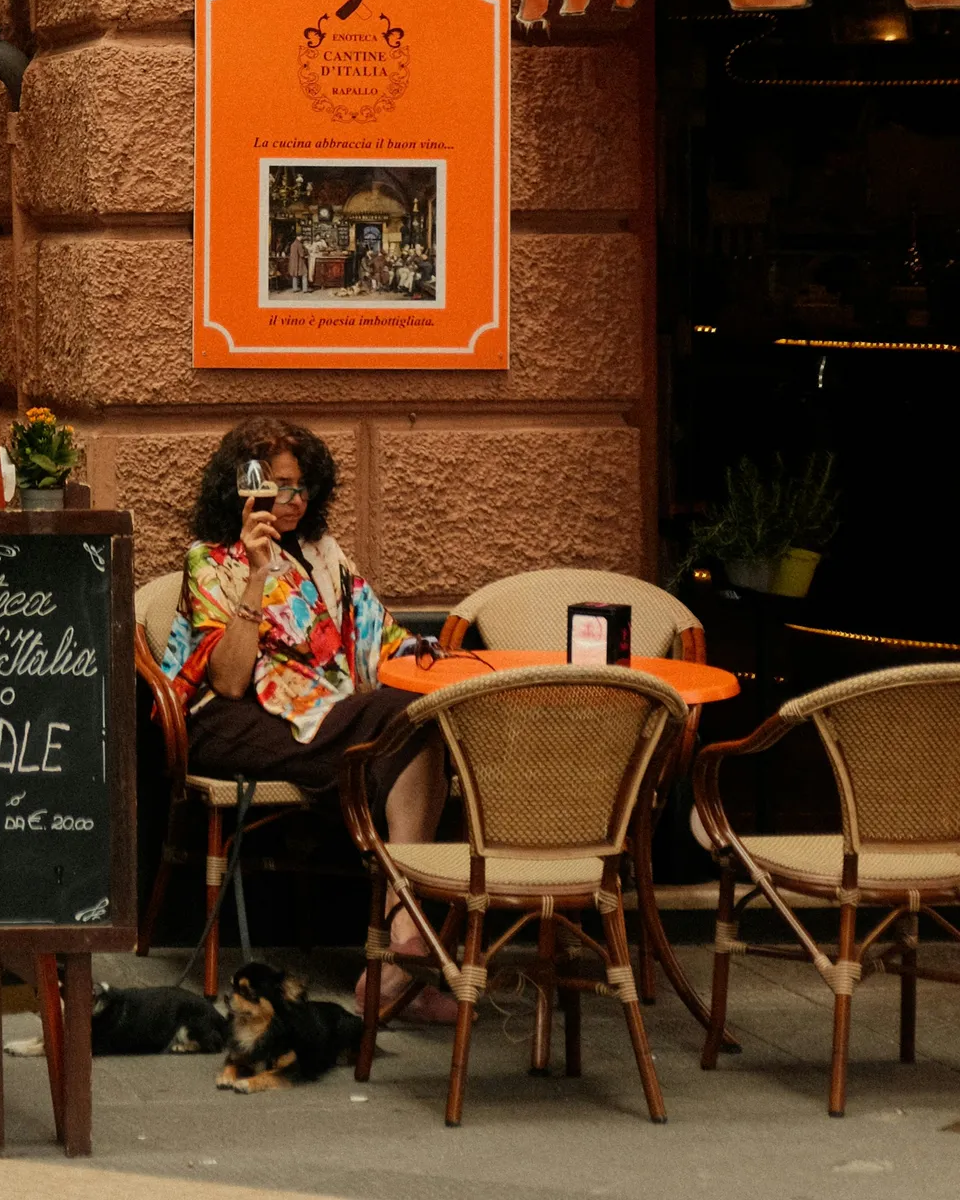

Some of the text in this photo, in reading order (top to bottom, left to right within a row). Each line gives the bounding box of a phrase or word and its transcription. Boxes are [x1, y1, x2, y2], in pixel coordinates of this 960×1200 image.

[332, 33, 378, 42] ENOTECA
[323, 51, 386, 62] CANTINE
[321, 66, 388, 77] D'ITALIA
[332, 87, 378, 96] RAPALLO
[253, 137, 455, 150] La cucina abbraccia il buon vino...
[268, 315, 435, 329] il vino è poesia imbottigliata.
